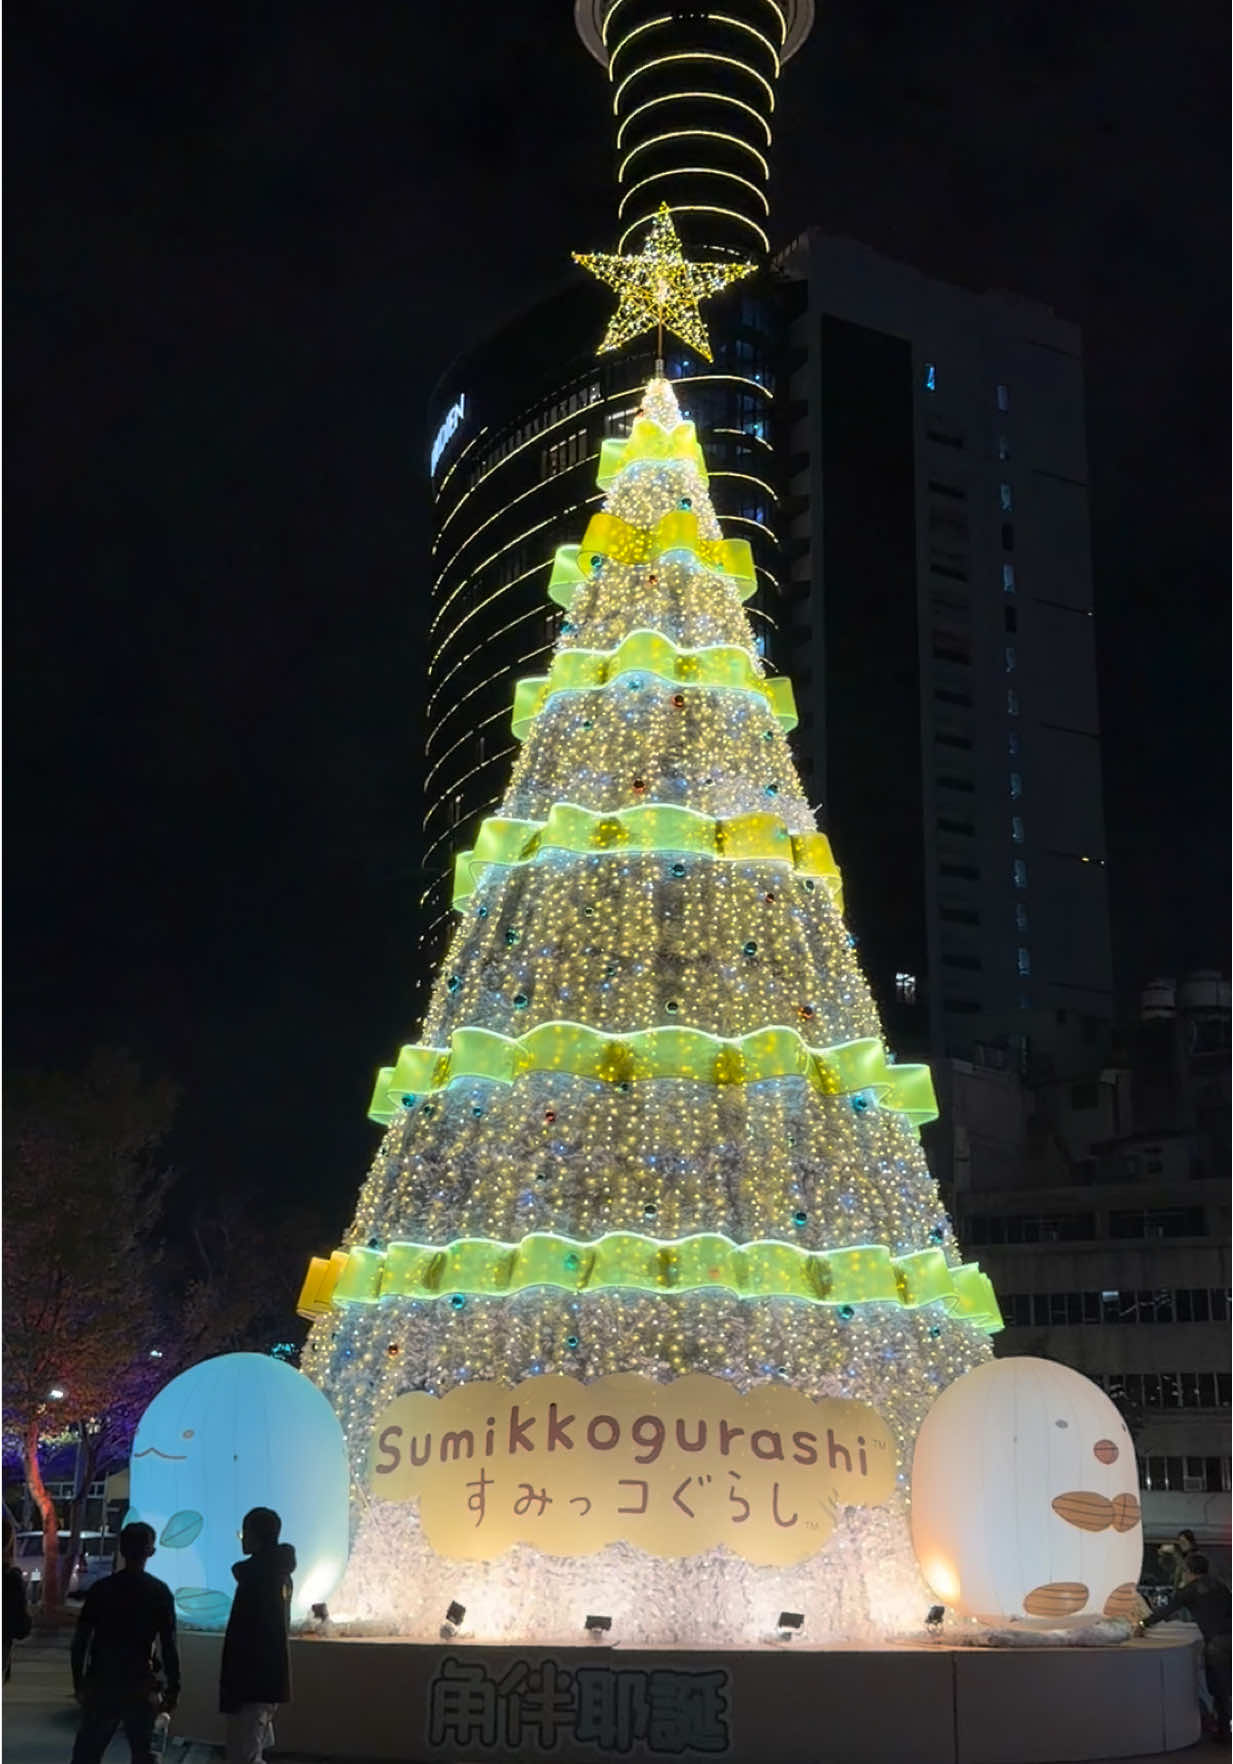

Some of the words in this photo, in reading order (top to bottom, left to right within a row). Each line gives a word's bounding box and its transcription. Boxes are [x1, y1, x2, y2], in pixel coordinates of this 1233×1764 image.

[375, 1402, 868, 1476] Sumikkogurashi
[466, 1468, 798, 1528] すみっコぐらし
[428, 1656, 730, 1754] 角伴耶誕
